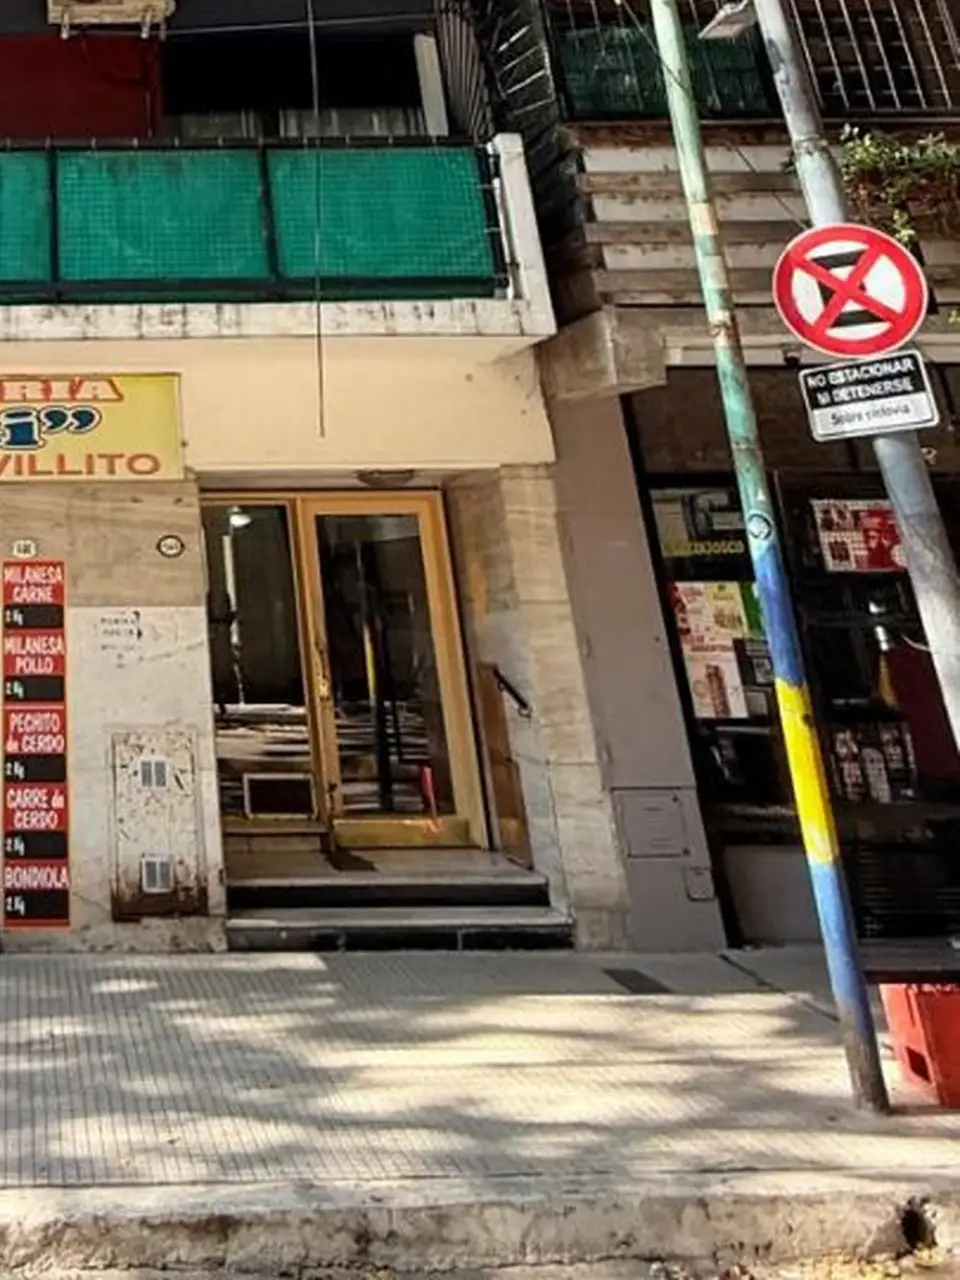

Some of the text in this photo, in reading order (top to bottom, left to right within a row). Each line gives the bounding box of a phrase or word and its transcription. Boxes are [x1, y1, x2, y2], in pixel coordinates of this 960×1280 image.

[807, 358, 915, 389] NO ESTACIONAR
[832, 376, 914, 403] DETENERSE
[4, 565, 62, 584] MILANESA
[12, 586, 53, 603] CARNE
[4, 635, 65, 655] MILANESA
[15, 656, 54, 674] POLLO
[9, 712, 61, 732] PECHITO
[21, 734, 65, 753] CERDO
[6, 788, 48, 809] CARRE
[13, 810, 58, 830] CERDO
[4, 866, 69, 889] BONDIOLA
